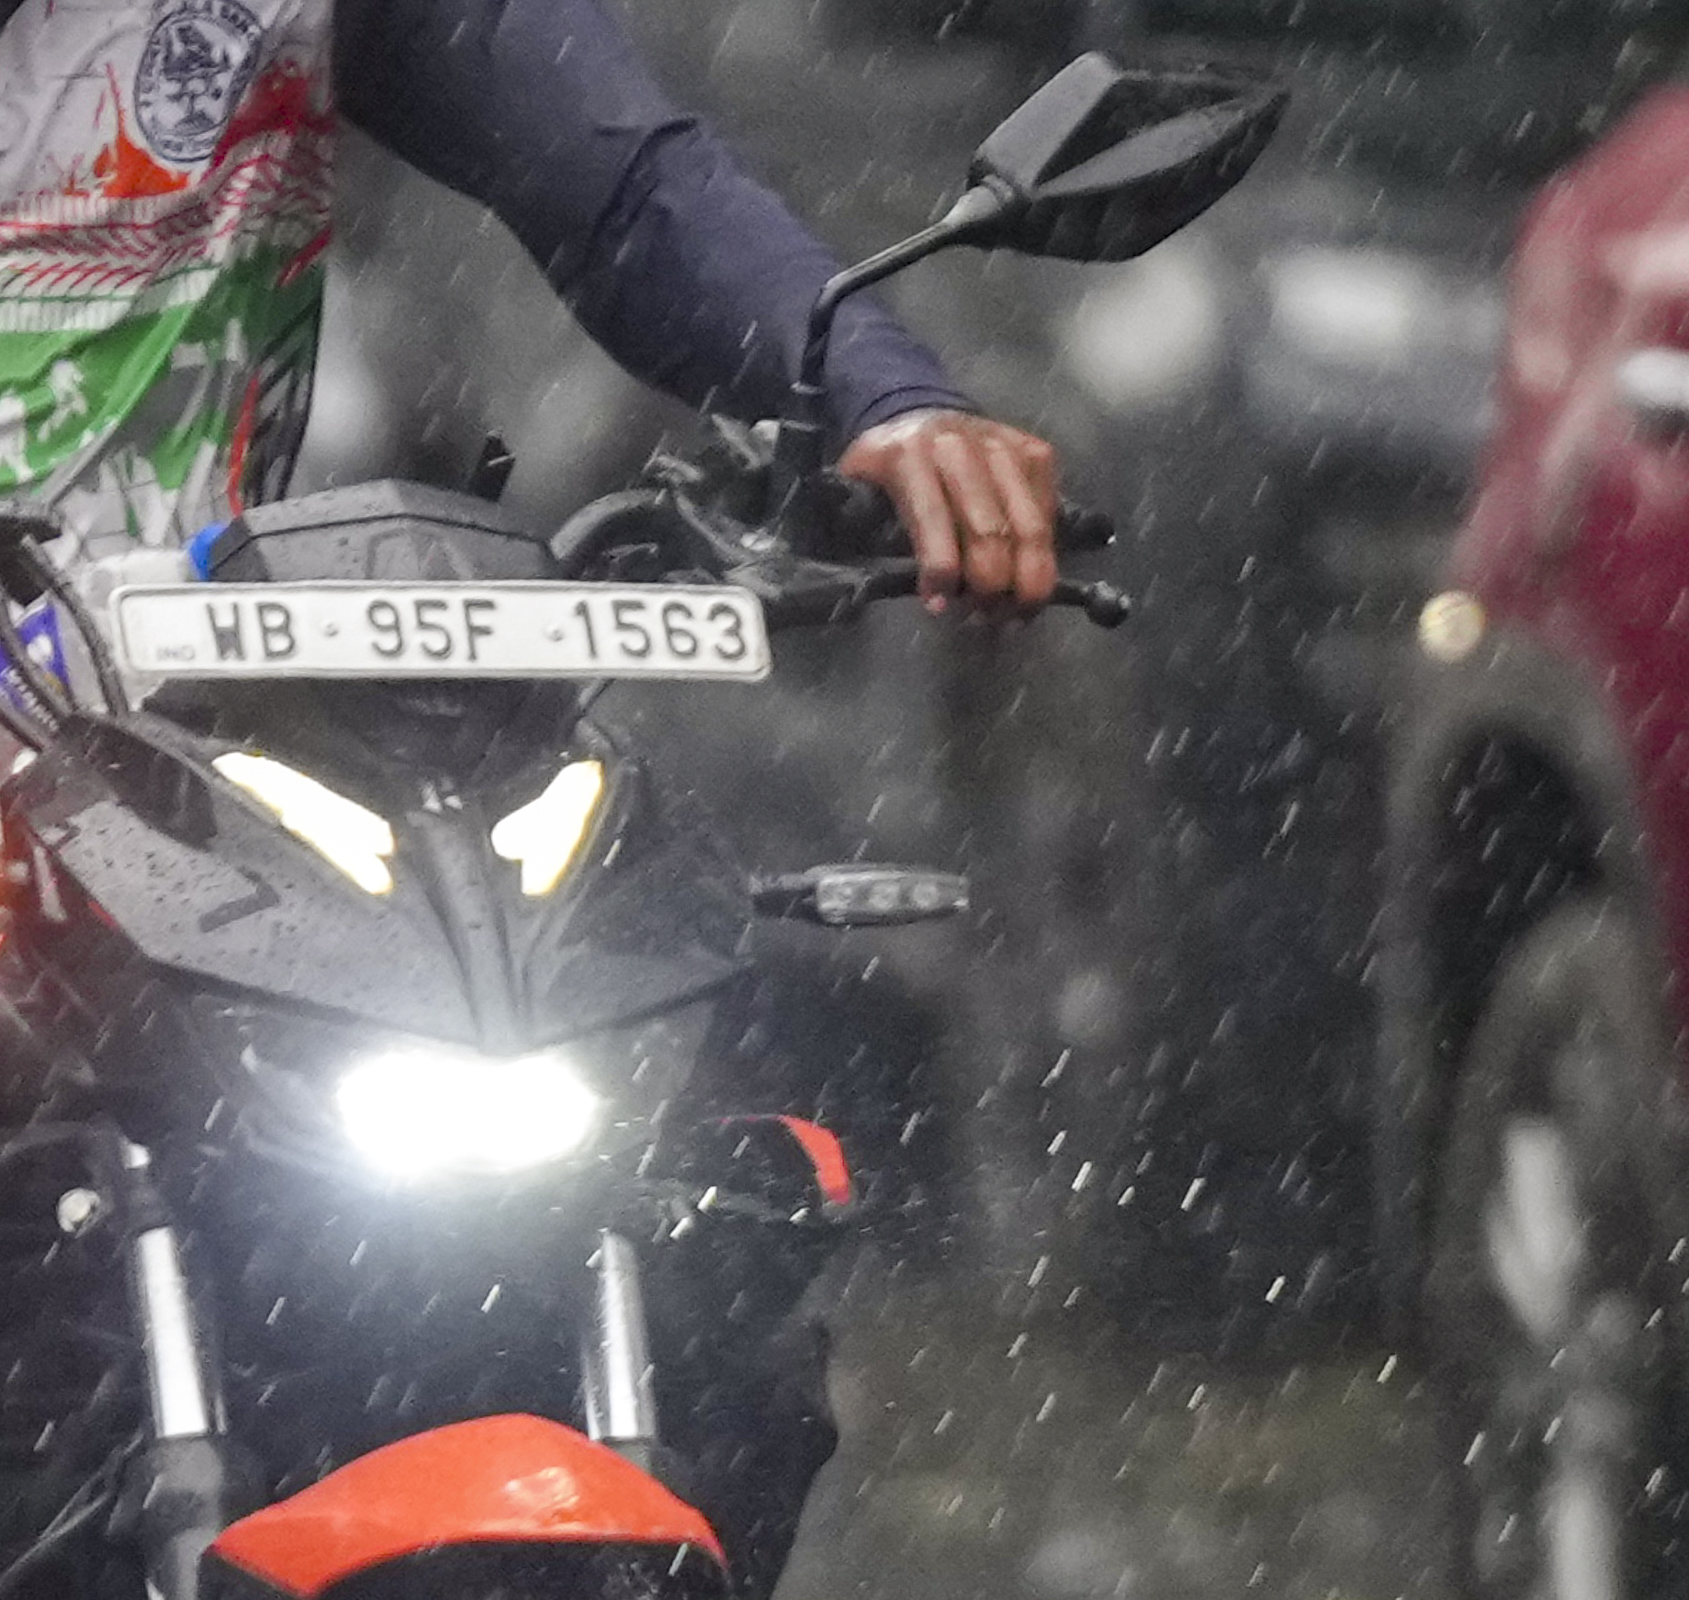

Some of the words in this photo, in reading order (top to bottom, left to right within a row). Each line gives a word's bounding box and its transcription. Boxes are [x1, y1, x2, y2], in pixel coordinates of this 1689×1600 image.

[205, 600, 297, 662] WB
[365, 598, 497, 663] 95F
[573, 598, 748, 662] 1563
